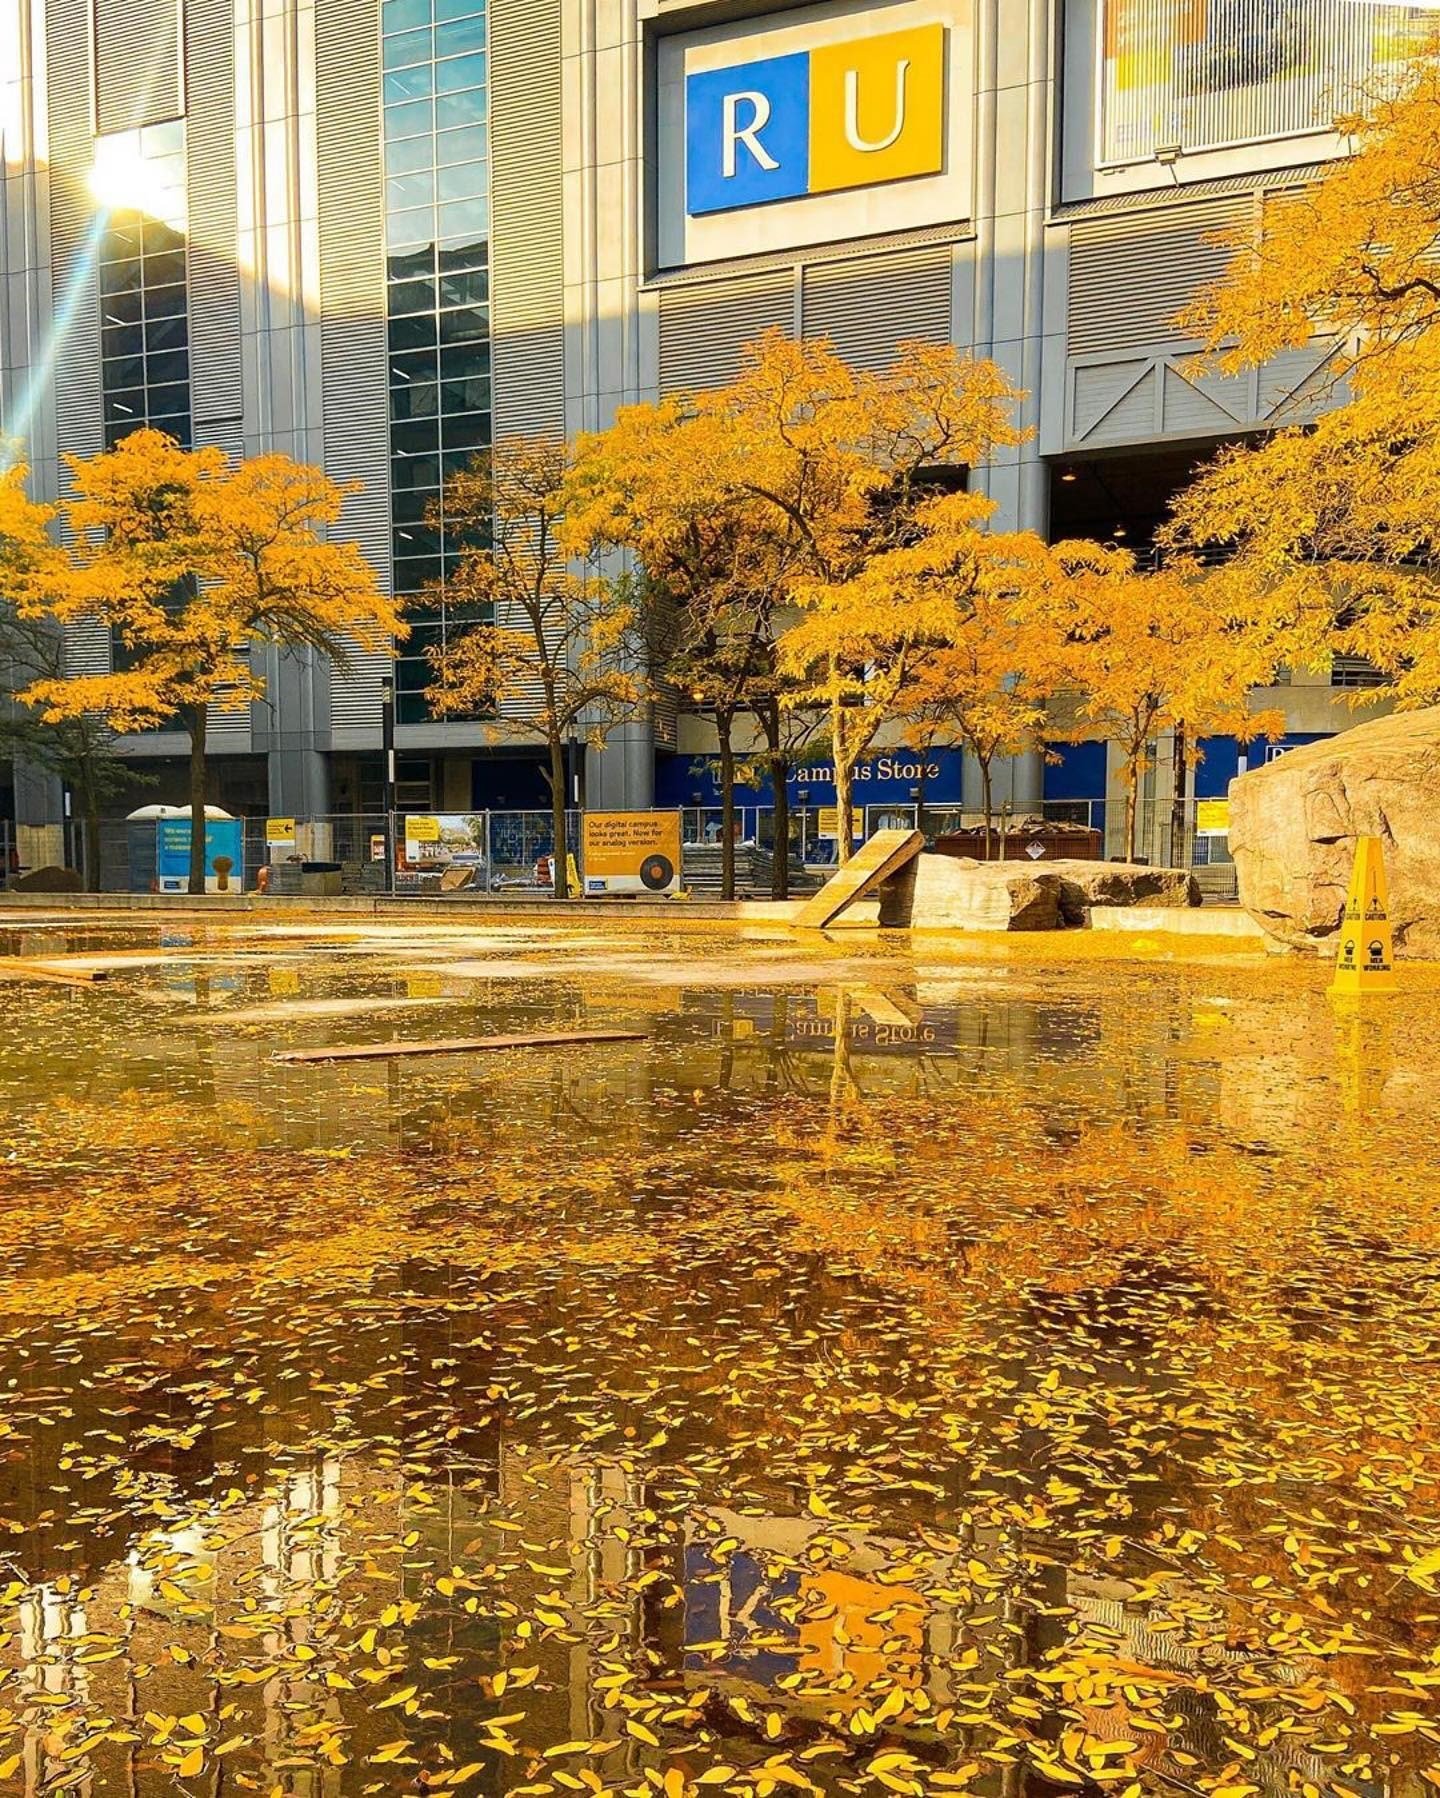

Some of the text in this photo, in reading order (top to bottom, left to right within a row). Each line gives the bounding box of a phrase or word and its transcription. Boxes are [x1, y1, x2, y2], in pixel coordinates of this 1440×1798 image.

[877, 758, 940, 780] Store
[604, 820, 627, 829] digital
[628, 821, 658, 829] campus
[588, 829, 663, 838] looks great. Now for
